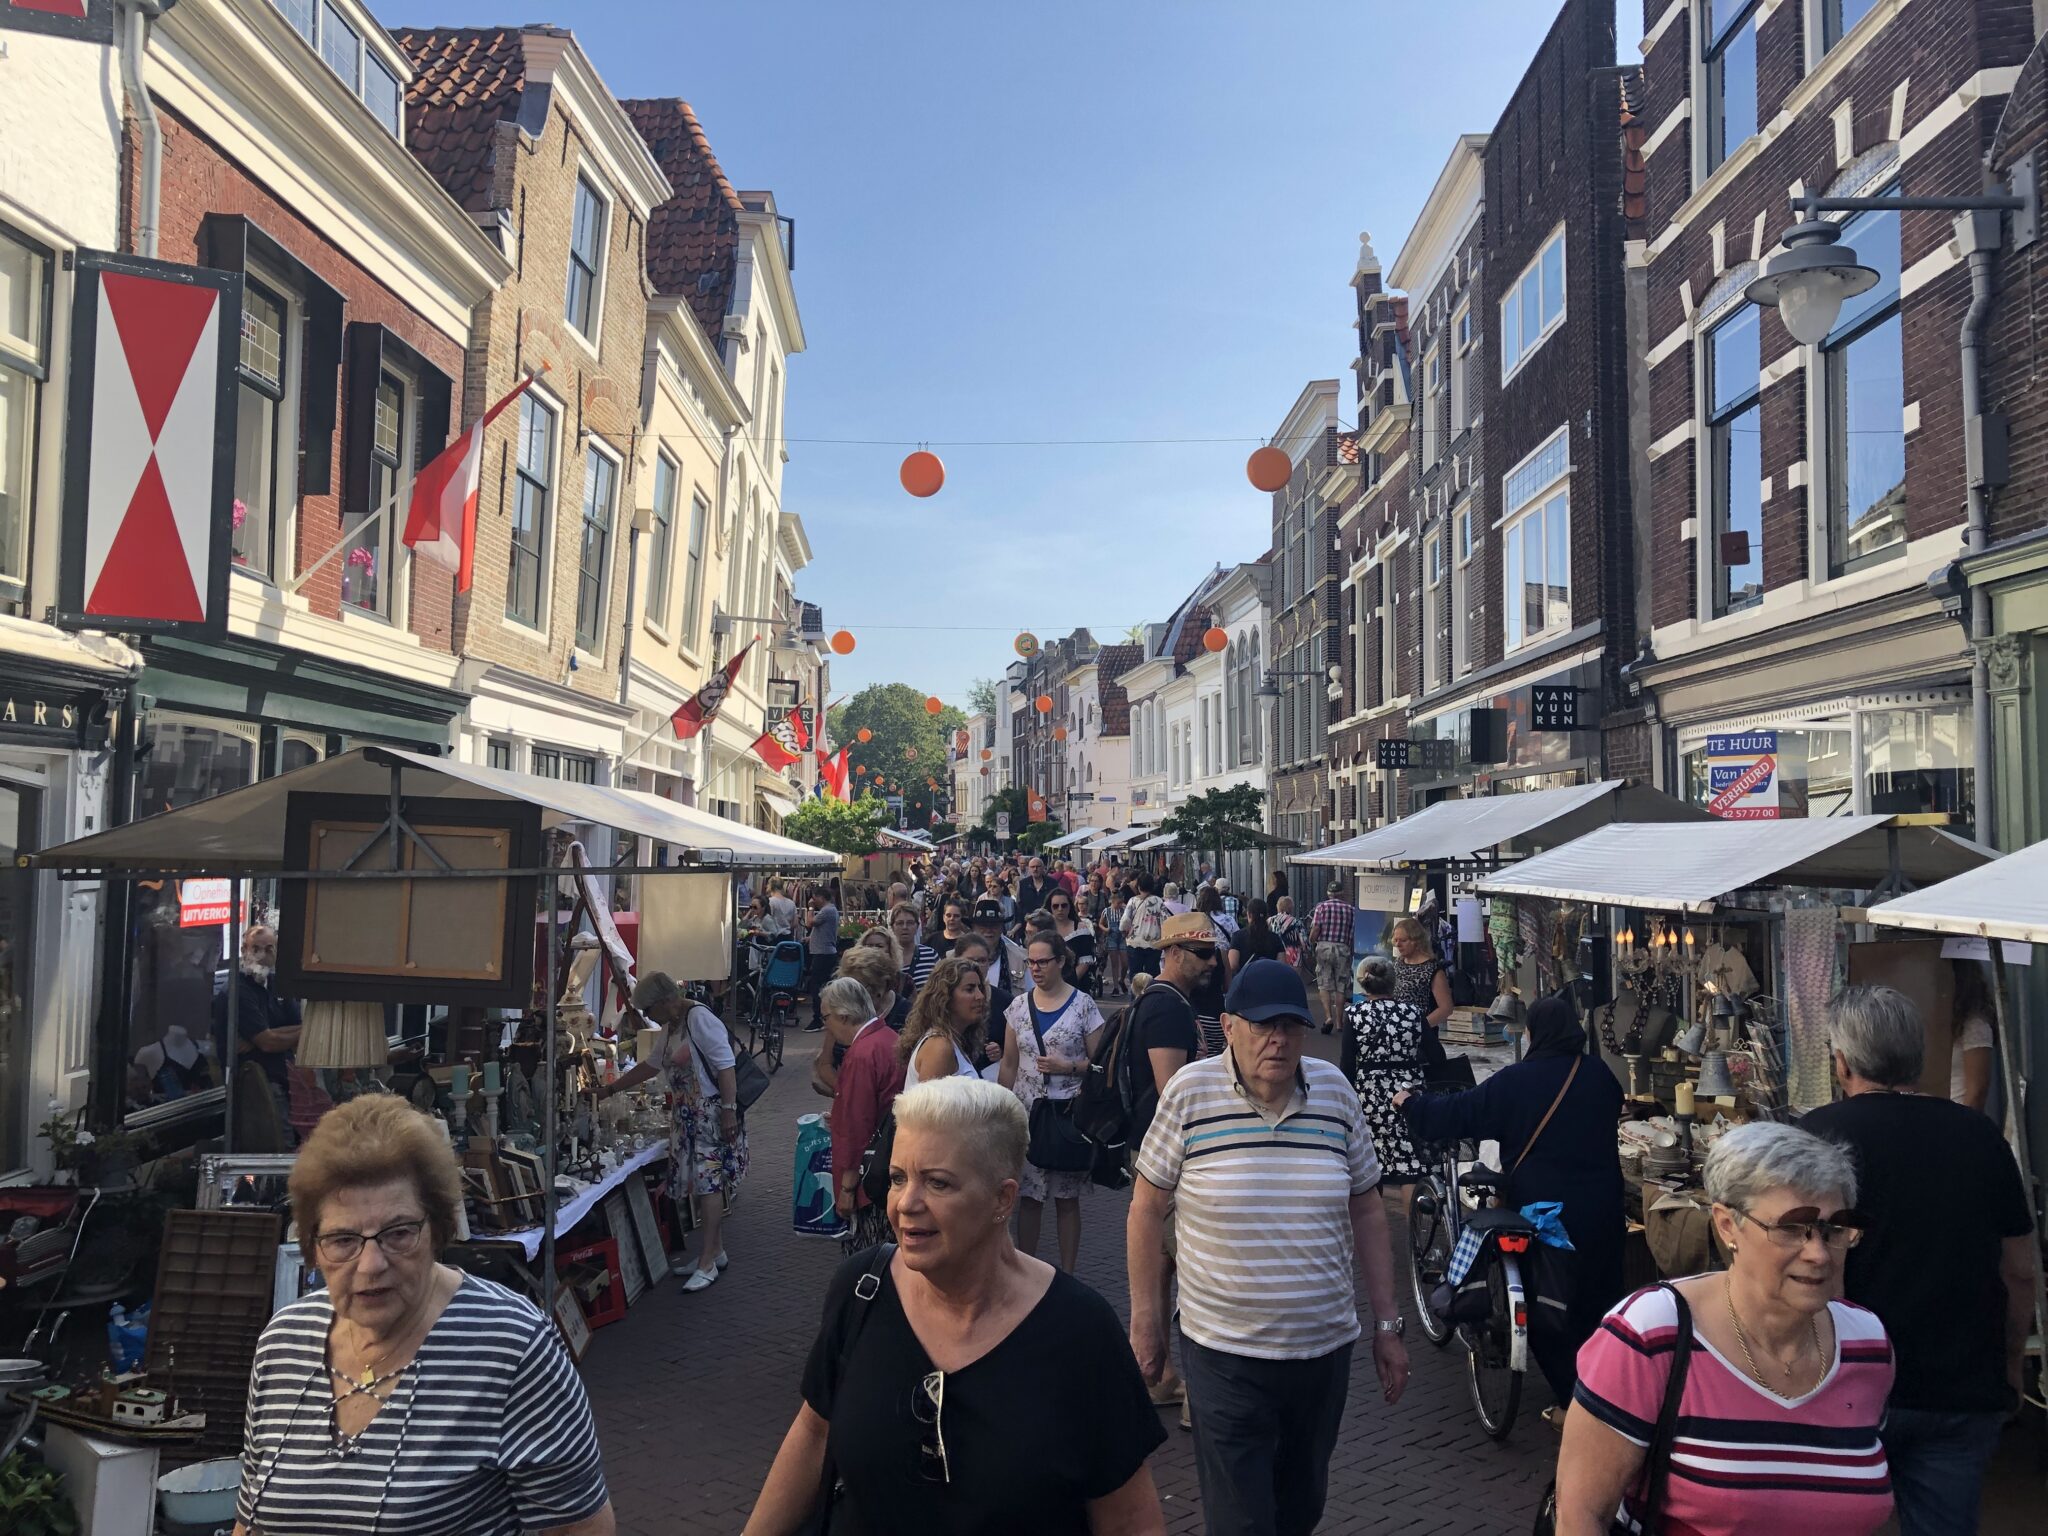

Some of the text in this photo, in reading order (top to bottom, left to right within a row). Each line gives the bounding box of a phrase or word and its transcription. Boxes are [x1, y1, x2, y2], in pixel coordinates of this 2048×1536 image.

[1535, 691, 1573, 701] VAN
[1535, 703, 1573, 713] VUU
[1536, 715, 1573, 725] REN
[1707, 737, 1773, 751] TE HUUR
[1714, 768, 1738, 780] Van
[1713, 762, 1770, 811] VERHUURD
[1749, 809, 1761, 817] 77
[1762, 809, 1775, 817] 00
